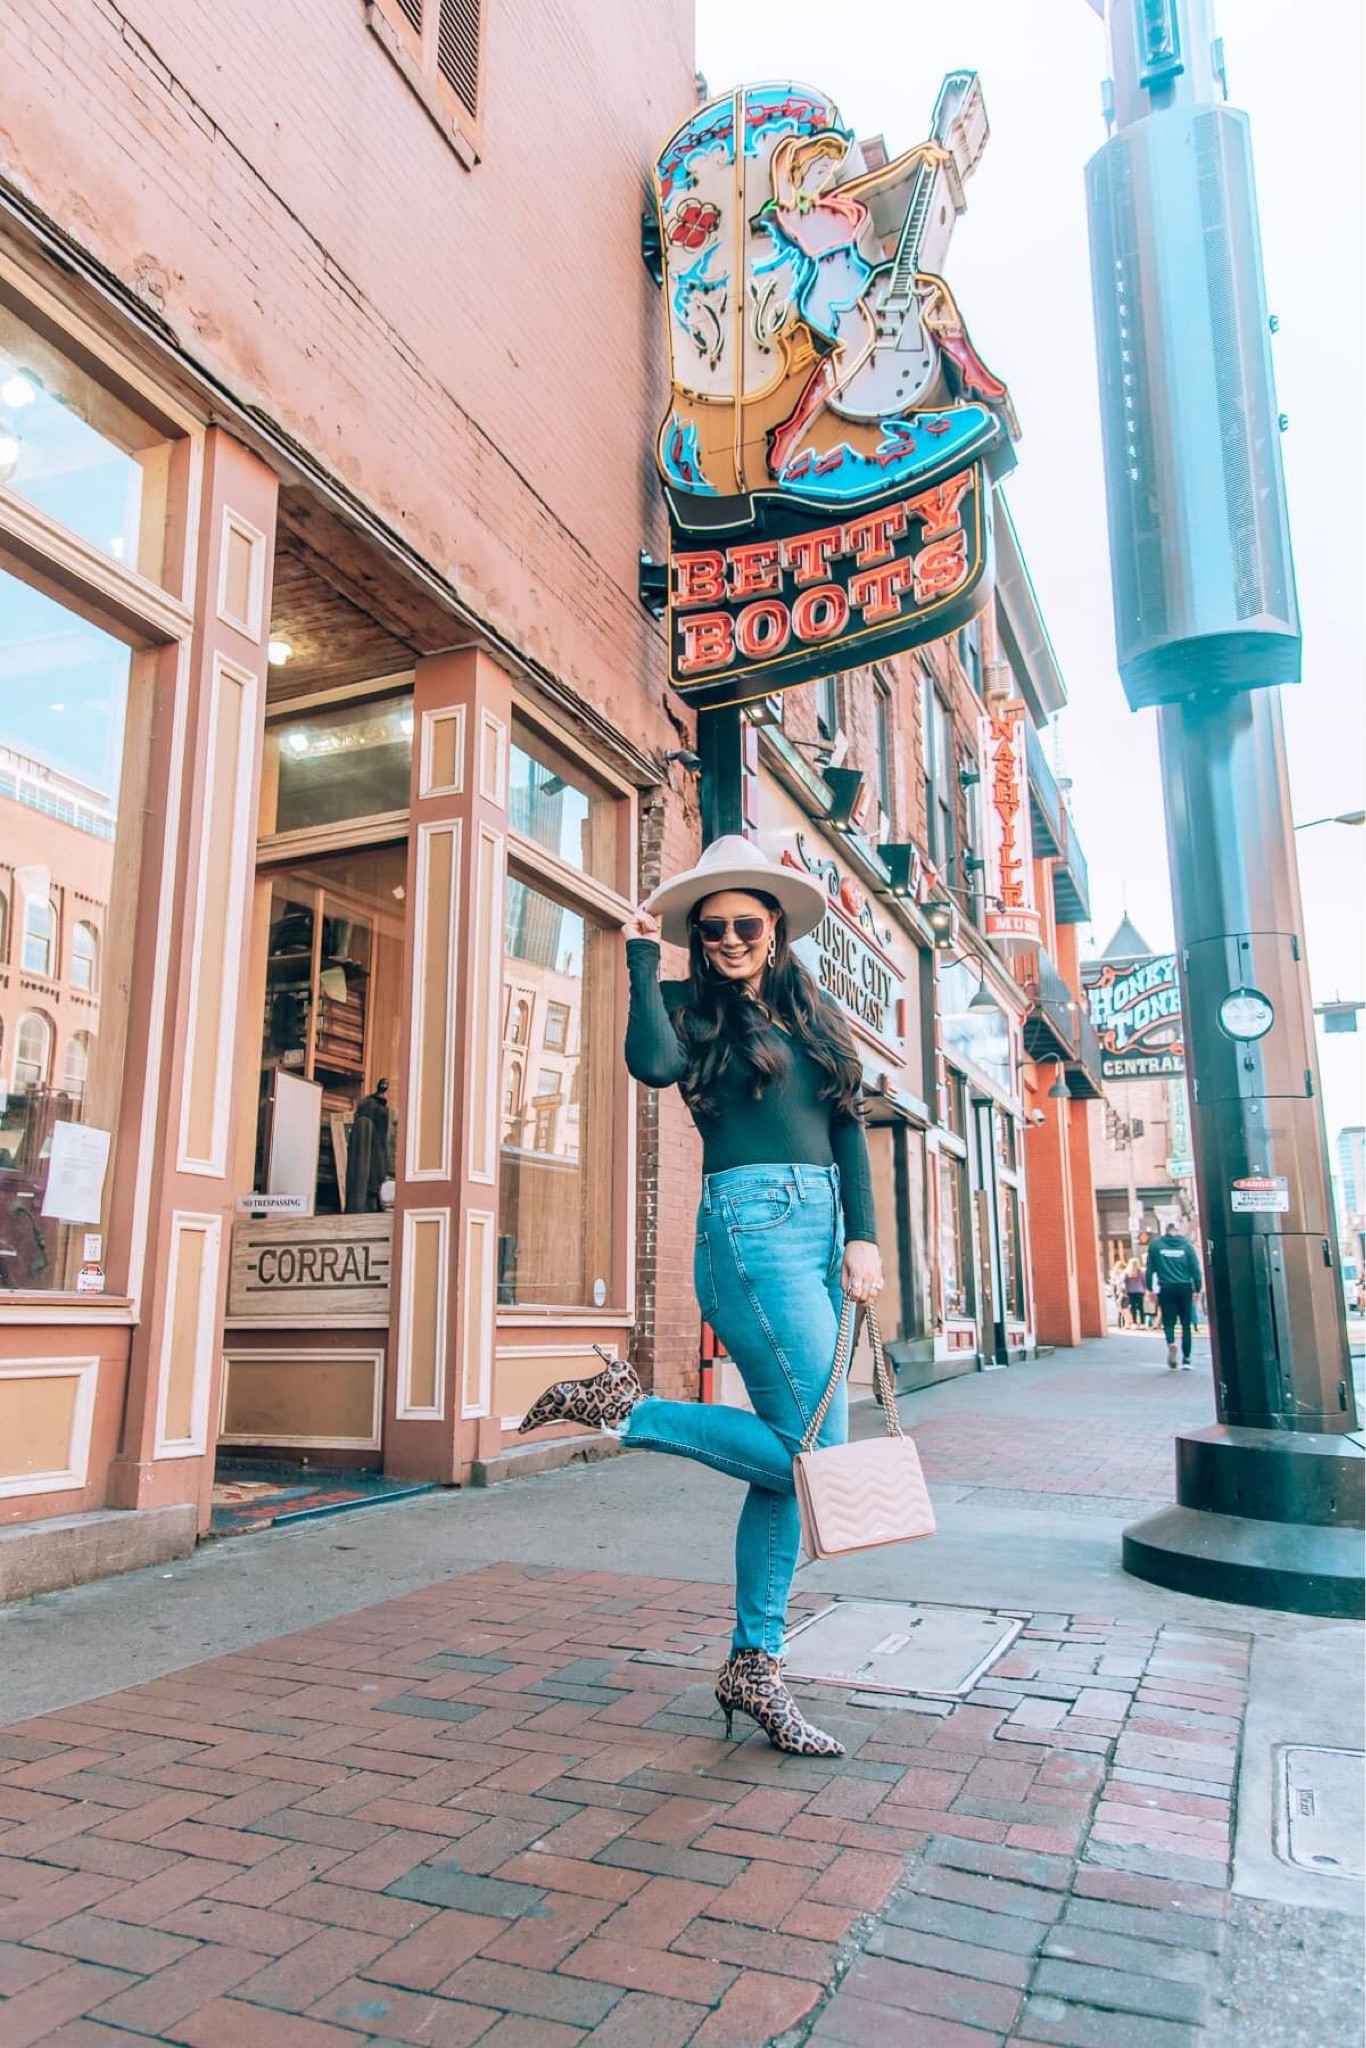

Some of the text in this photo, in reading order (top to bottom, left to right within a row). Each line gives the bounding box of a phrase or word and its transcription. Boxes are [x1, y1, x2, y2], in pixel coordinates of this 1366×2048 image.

[671, 469, 973, 610] BETTY
[678, 529, 967, 674] BOOTS
[991, 717, 1023, 907] NASHVILLE
[819, 954, 883, 1033] SHOWCASE
[862, 954, 892, 1007] CITY
[1089, 957, 1176, 1025] HONKY
[1103, 1056, 1184, 1076] CENTRAL
[258, 1246, 381, 1284] CORRAL
